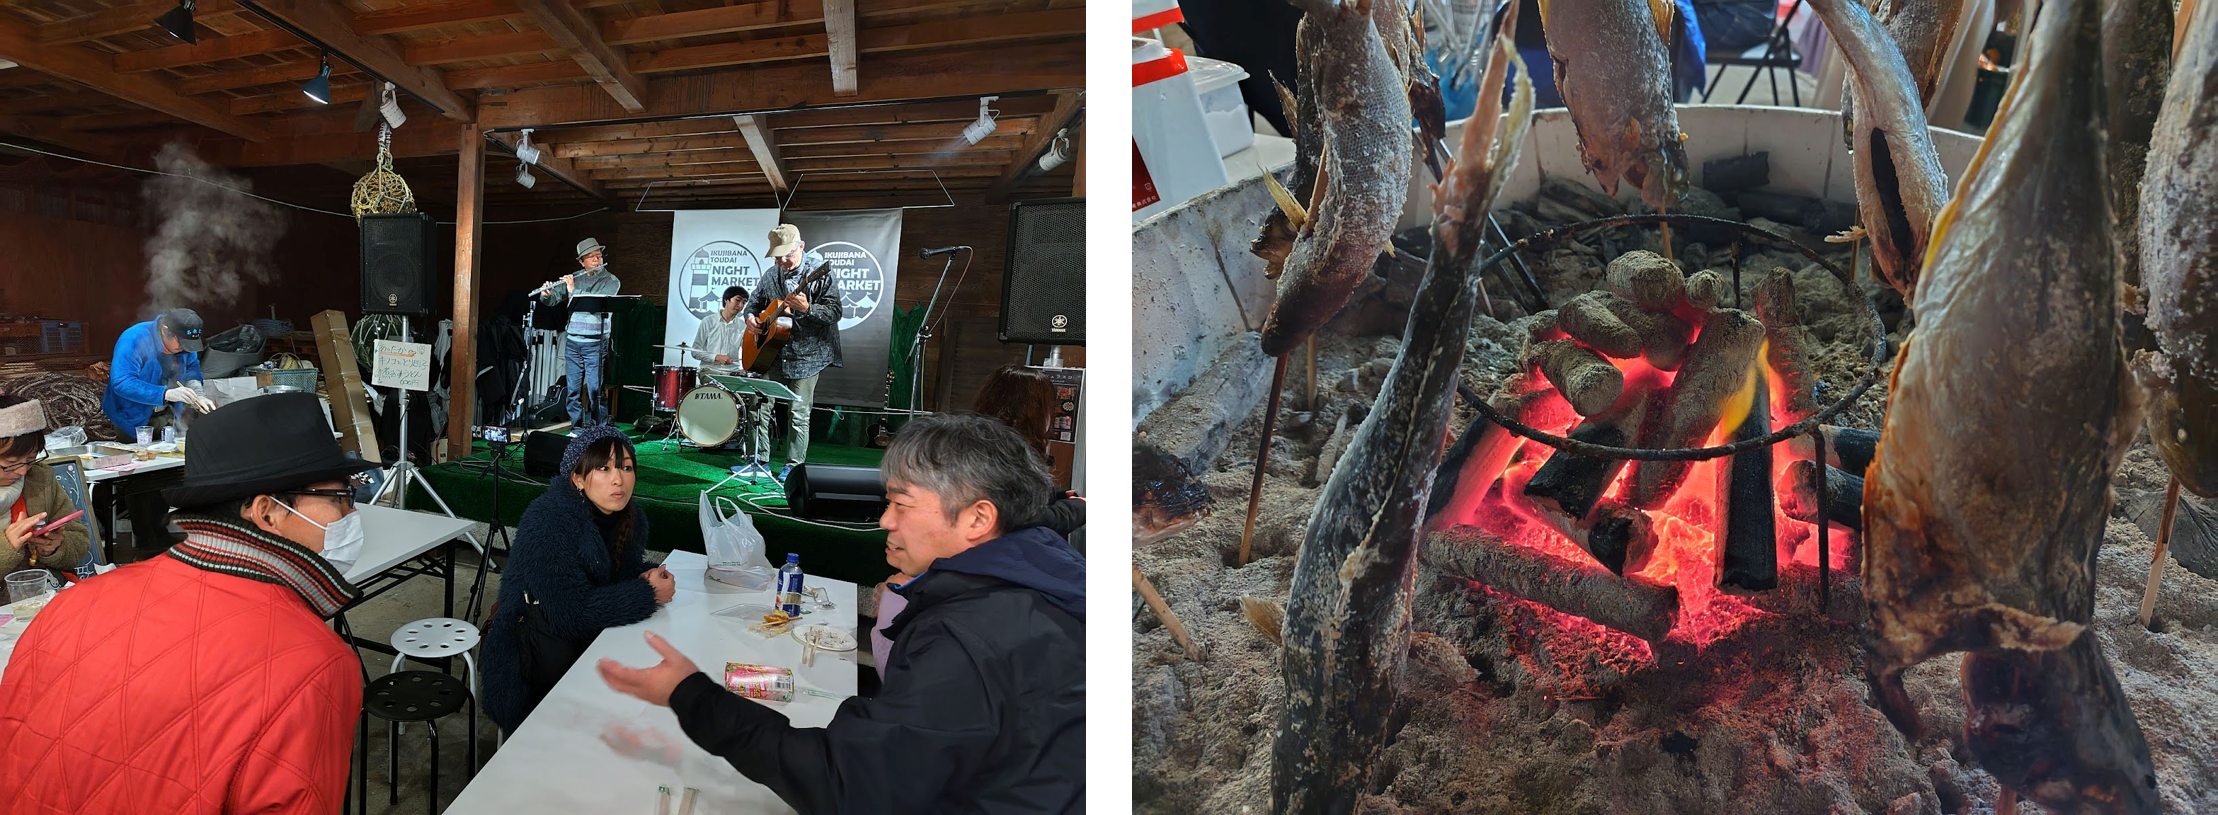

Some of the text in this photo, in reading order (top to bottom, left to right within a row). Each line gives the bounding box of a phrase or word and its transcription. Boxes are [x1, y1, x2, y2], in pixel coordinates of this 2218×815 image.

[824, 251, 866, 259] IKUJIBANA
[712, 266, 750, 275] NIGHT
[711, 276, 759, 287] MARKET
[837, 280, 880, 290] ARKET
